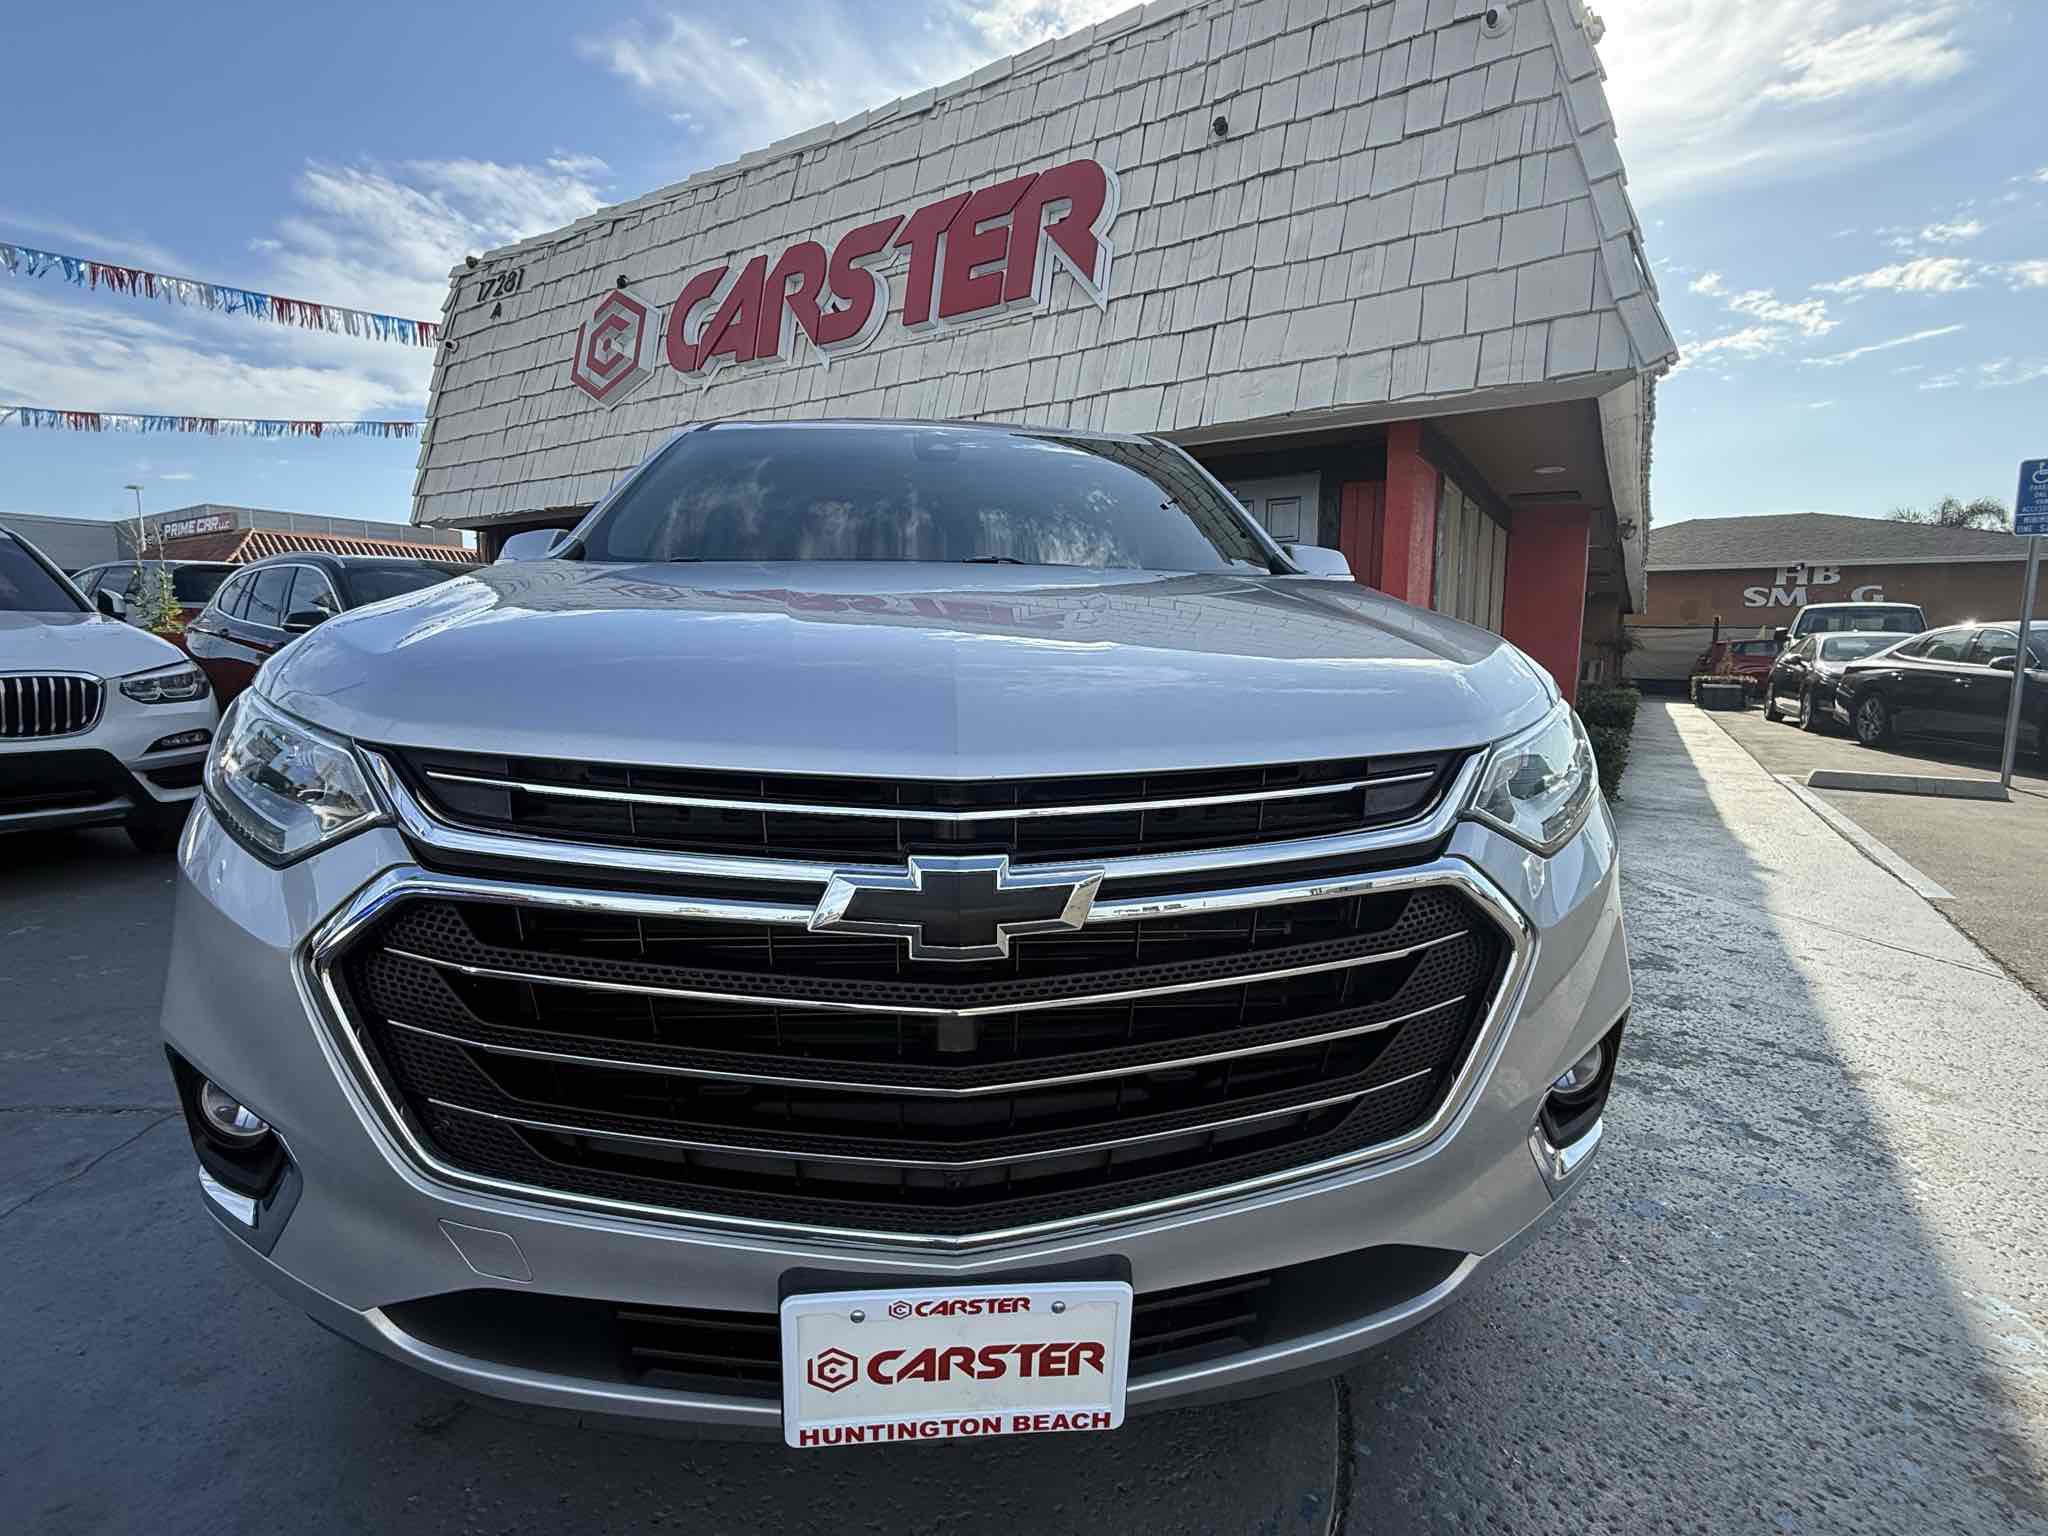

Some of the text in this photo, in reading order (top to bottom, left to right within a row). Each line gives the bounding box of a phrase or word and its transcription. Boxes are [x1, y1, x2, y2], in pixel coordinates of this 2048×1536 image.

[665, 158, 1112, 377] CARSTER
[164, 519, 196, 537] PRIME
[197, 516, 218, 532] CAR
[1775, 566, 1841, 585] HB
[915, 1296, 1031, 1318] CARSTER
[867, 1342, 1106, 1386] CARSTER
[800, 1411, 1111, 1447] HUNTINGTON BEACH
